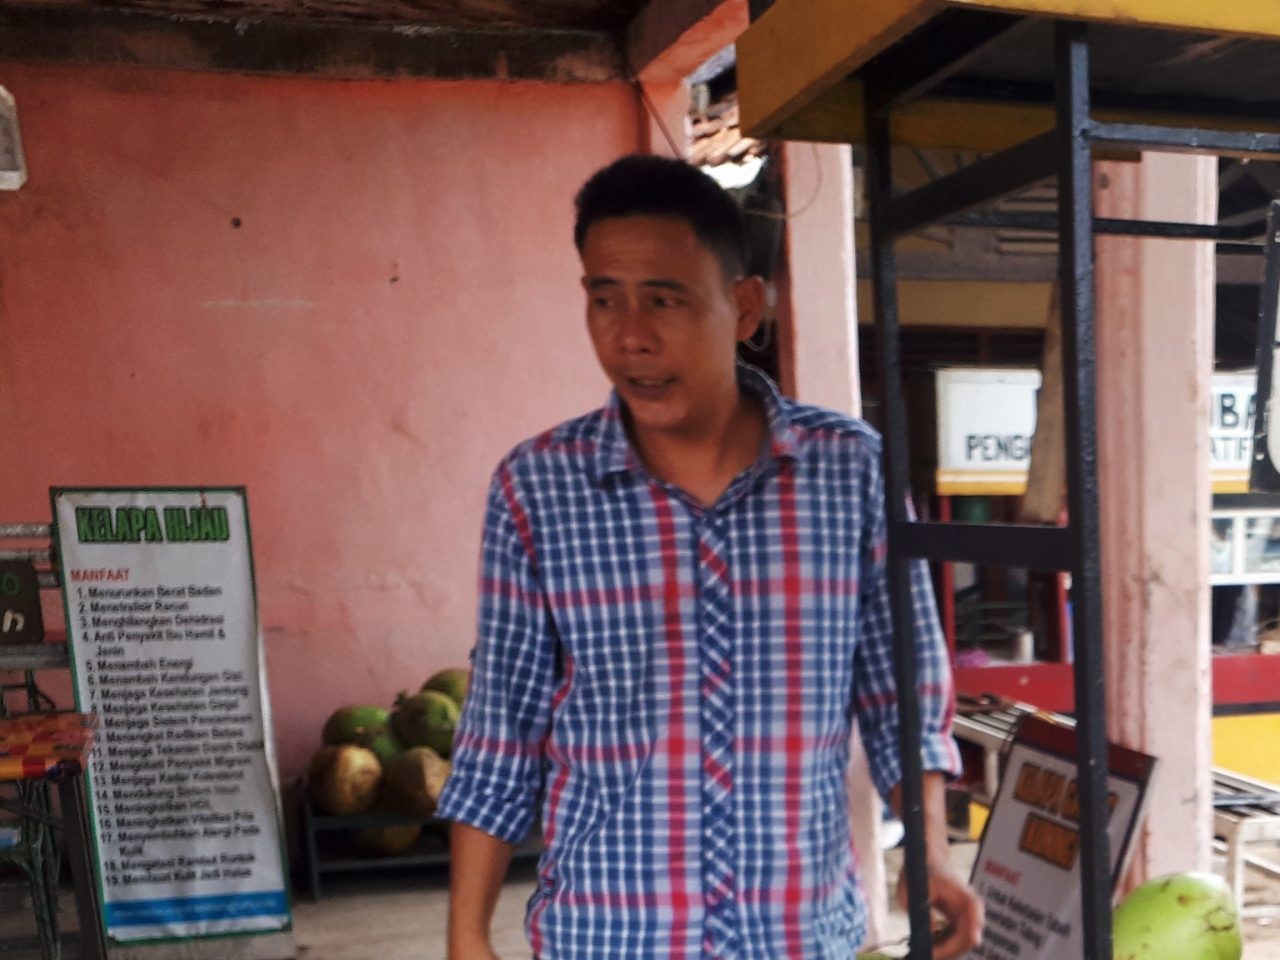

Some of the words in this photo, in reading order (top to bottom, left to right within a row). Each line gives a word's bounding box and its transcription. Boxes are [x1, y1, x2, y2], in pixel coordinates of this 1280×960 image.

[965, 433, 1032, 461] PENG
[75, 506, 163, 543] KELAPA
[163, 506, 230, 543] HIJAU
[71, 568, 129, 582] MANFAAT
